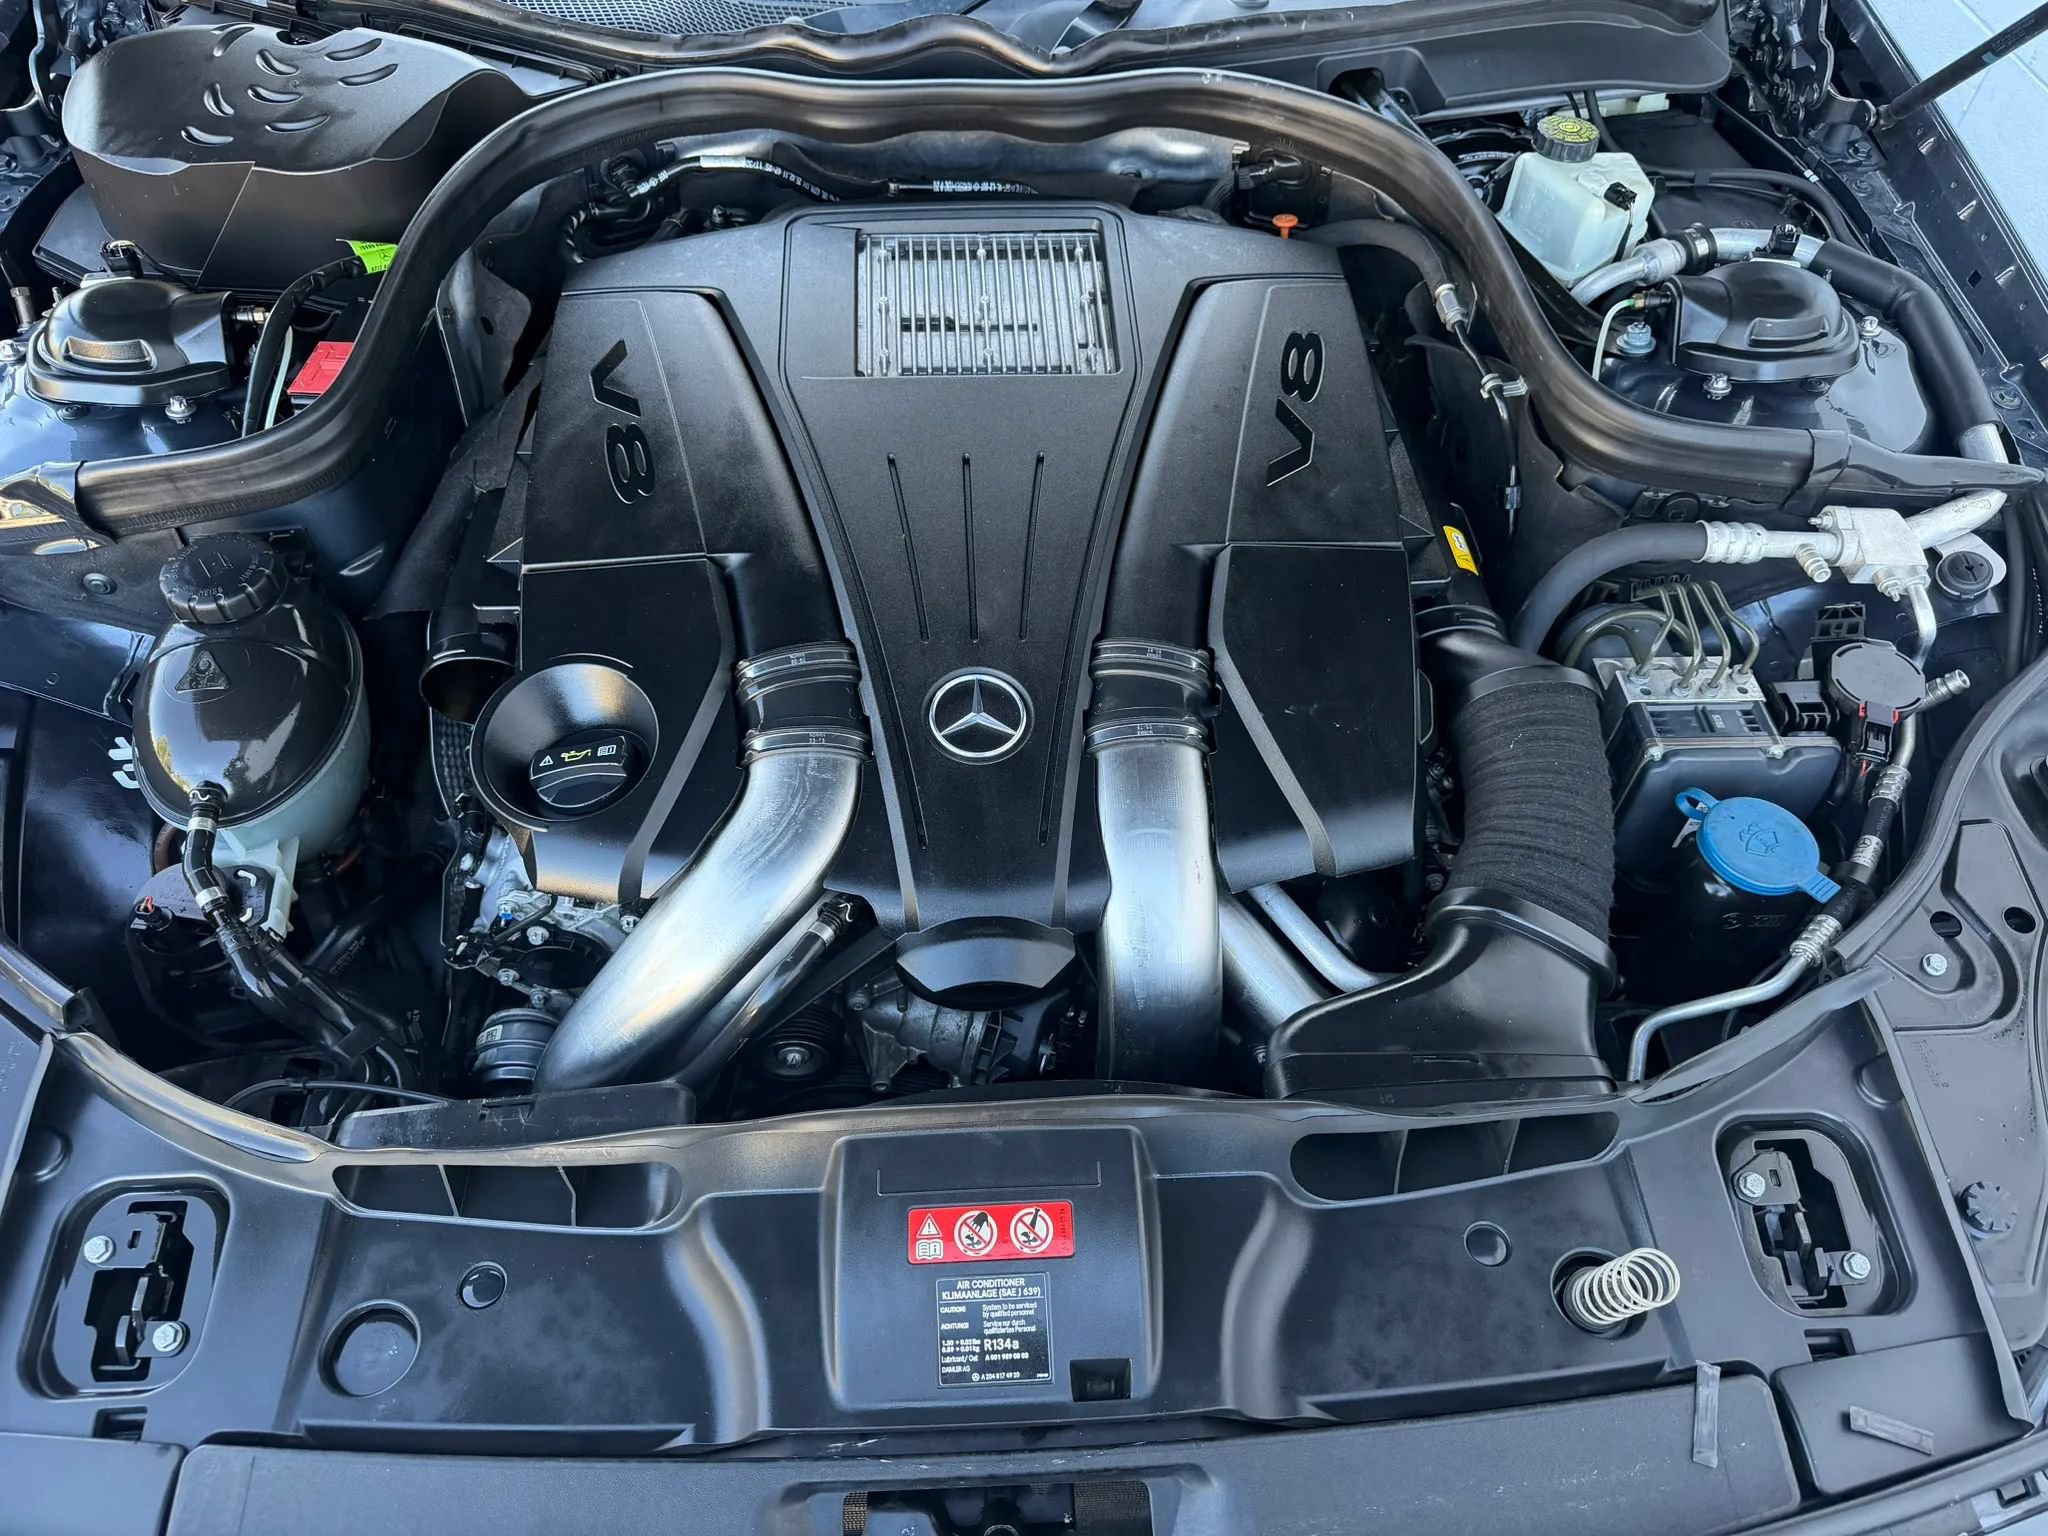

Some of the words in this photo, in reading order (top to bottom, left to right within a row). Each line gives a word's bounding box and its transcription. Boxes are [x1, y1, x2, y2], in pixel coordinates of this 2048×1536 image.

[1266, 330, 1326, 487] V8
[589, 338, 656, 505] V8
[956, 1280, 970, 1290] AIR
[971, 1278, 1025, 1288] CONDITIONER
[942, 1289, 997, 1300] KLIMAANLAGE
[999, 1287, 1016, 1299] (SAE
[1023, 1286, 1041, 1297] 639)
[982, 1304, 1001, 1312] System
[982, 1311, 989, 1319] by
[990, 1310, 1010, 1318] qualified
[1011, 1308, 1035, 1317] personnel
[983, 1320, 1002, 1328] Service
[983, 1338, 1020, 1351] R134a
